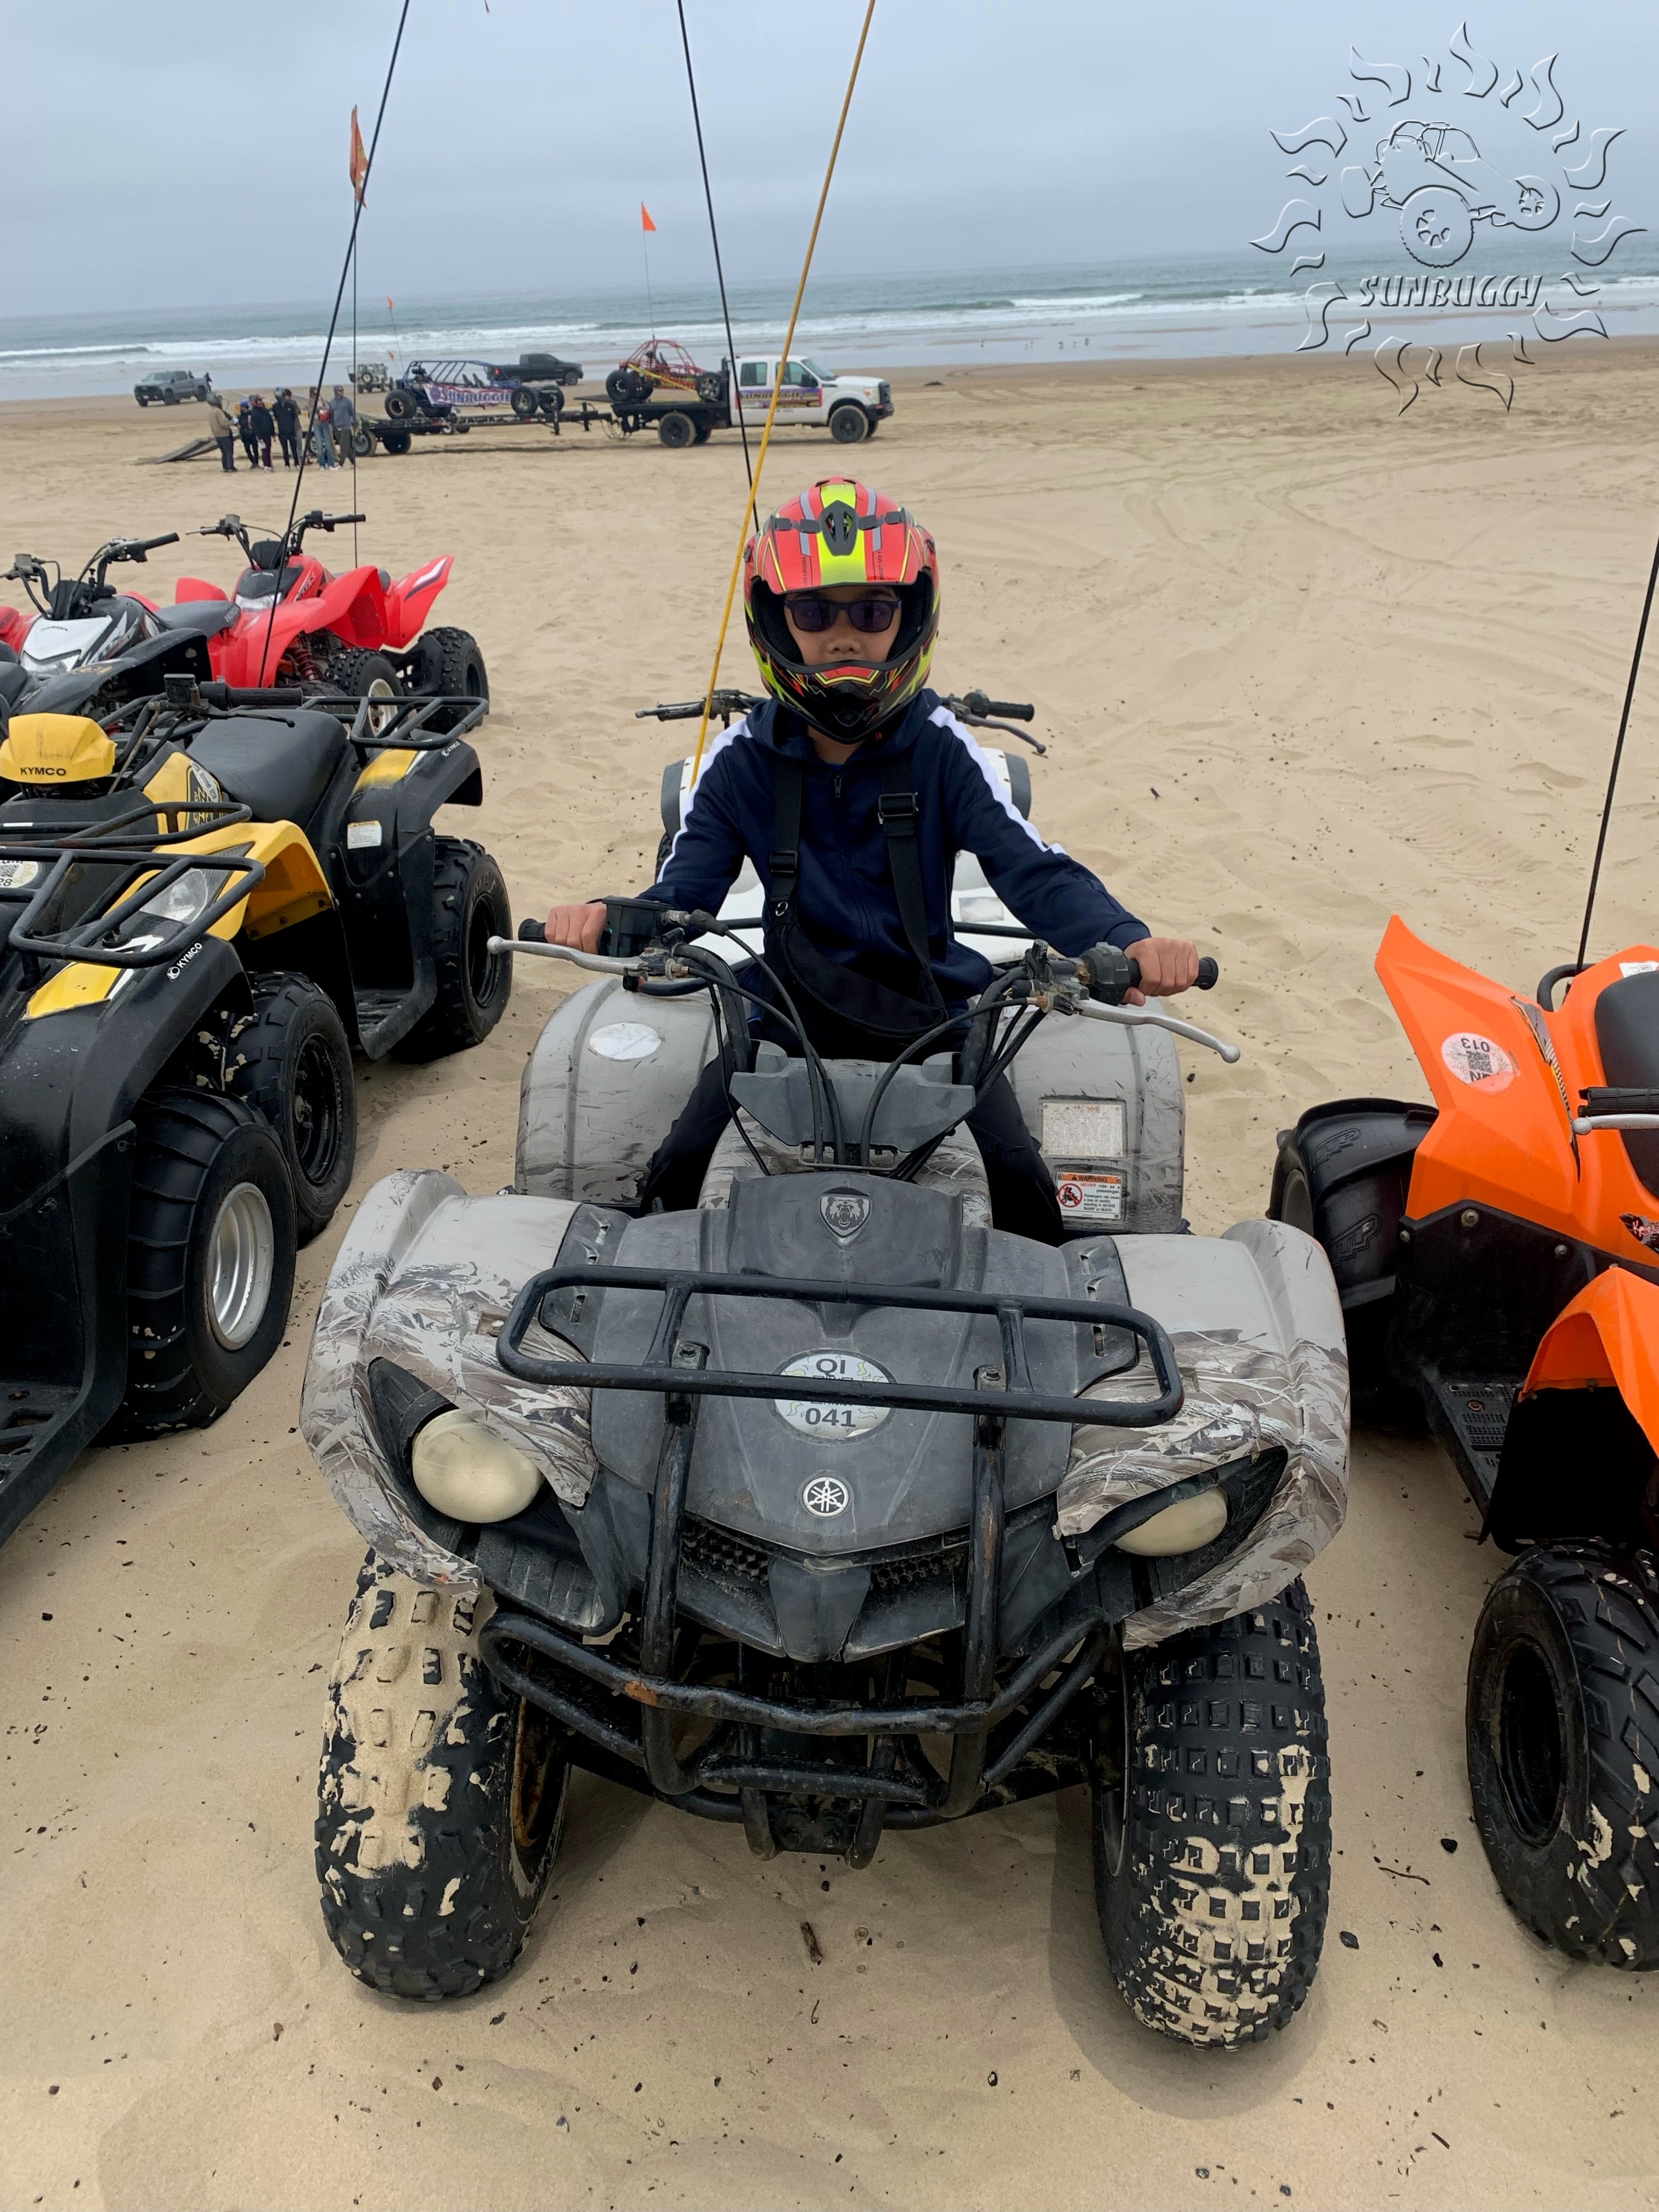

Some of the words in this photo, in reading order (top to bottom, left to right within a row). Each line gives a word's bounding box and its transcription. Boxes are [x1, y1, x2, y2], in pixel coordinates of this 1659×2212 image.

[20, 767, 67, 776] KYMCO
[176, 943, 202, 969] KYMCO
[1460, 1037, 1490, 1052] 013
[816, 1358, 846, 1377] QI
[805, 1408, 856, 1427] 041
